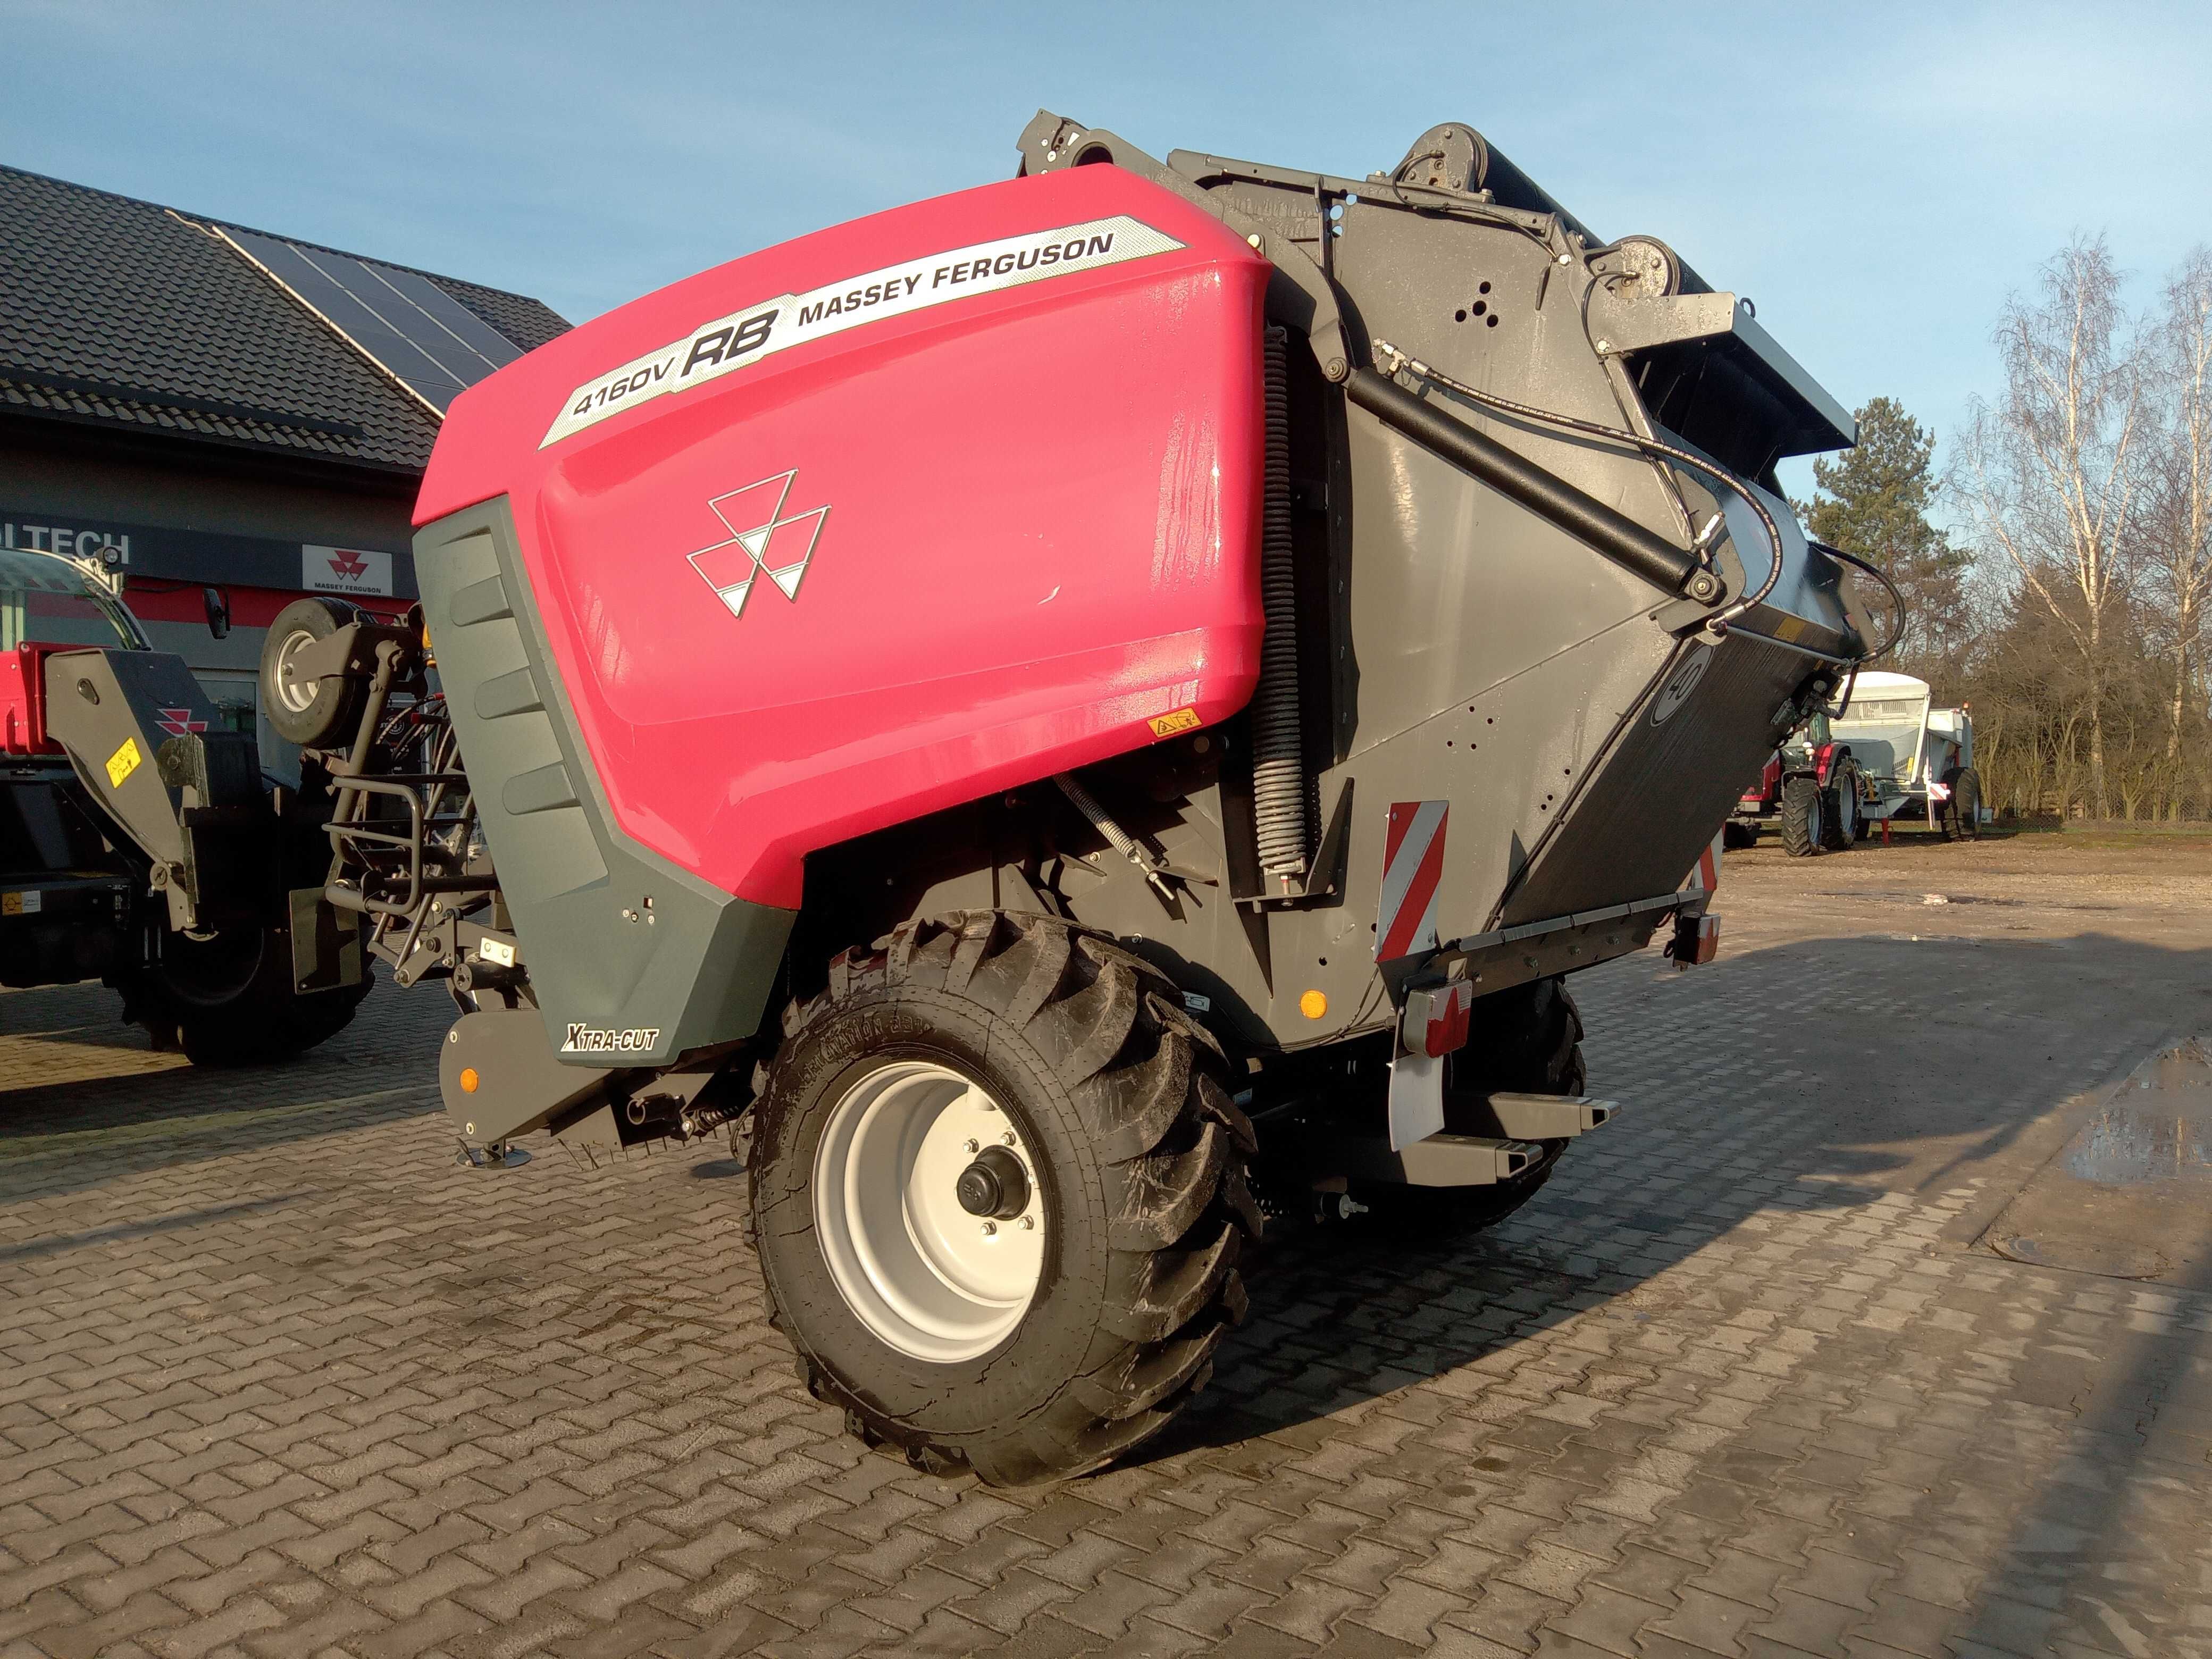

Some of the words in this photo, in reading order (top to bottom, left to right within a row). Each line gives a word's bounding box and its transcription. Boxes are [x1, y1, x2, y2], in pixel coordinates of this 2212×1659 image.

[573, 357, 675, 415] 4160V
[681, 309, 779, 378] RB
[798, 273, 922, 326] MASSEY
[932, 233, 1114, 289] FERGUSON
[22, 525, 129, 565] TECH
[1667, 663, 1703, 700] 40
[560, 1023, 660, 1052] XTRA-CUT
